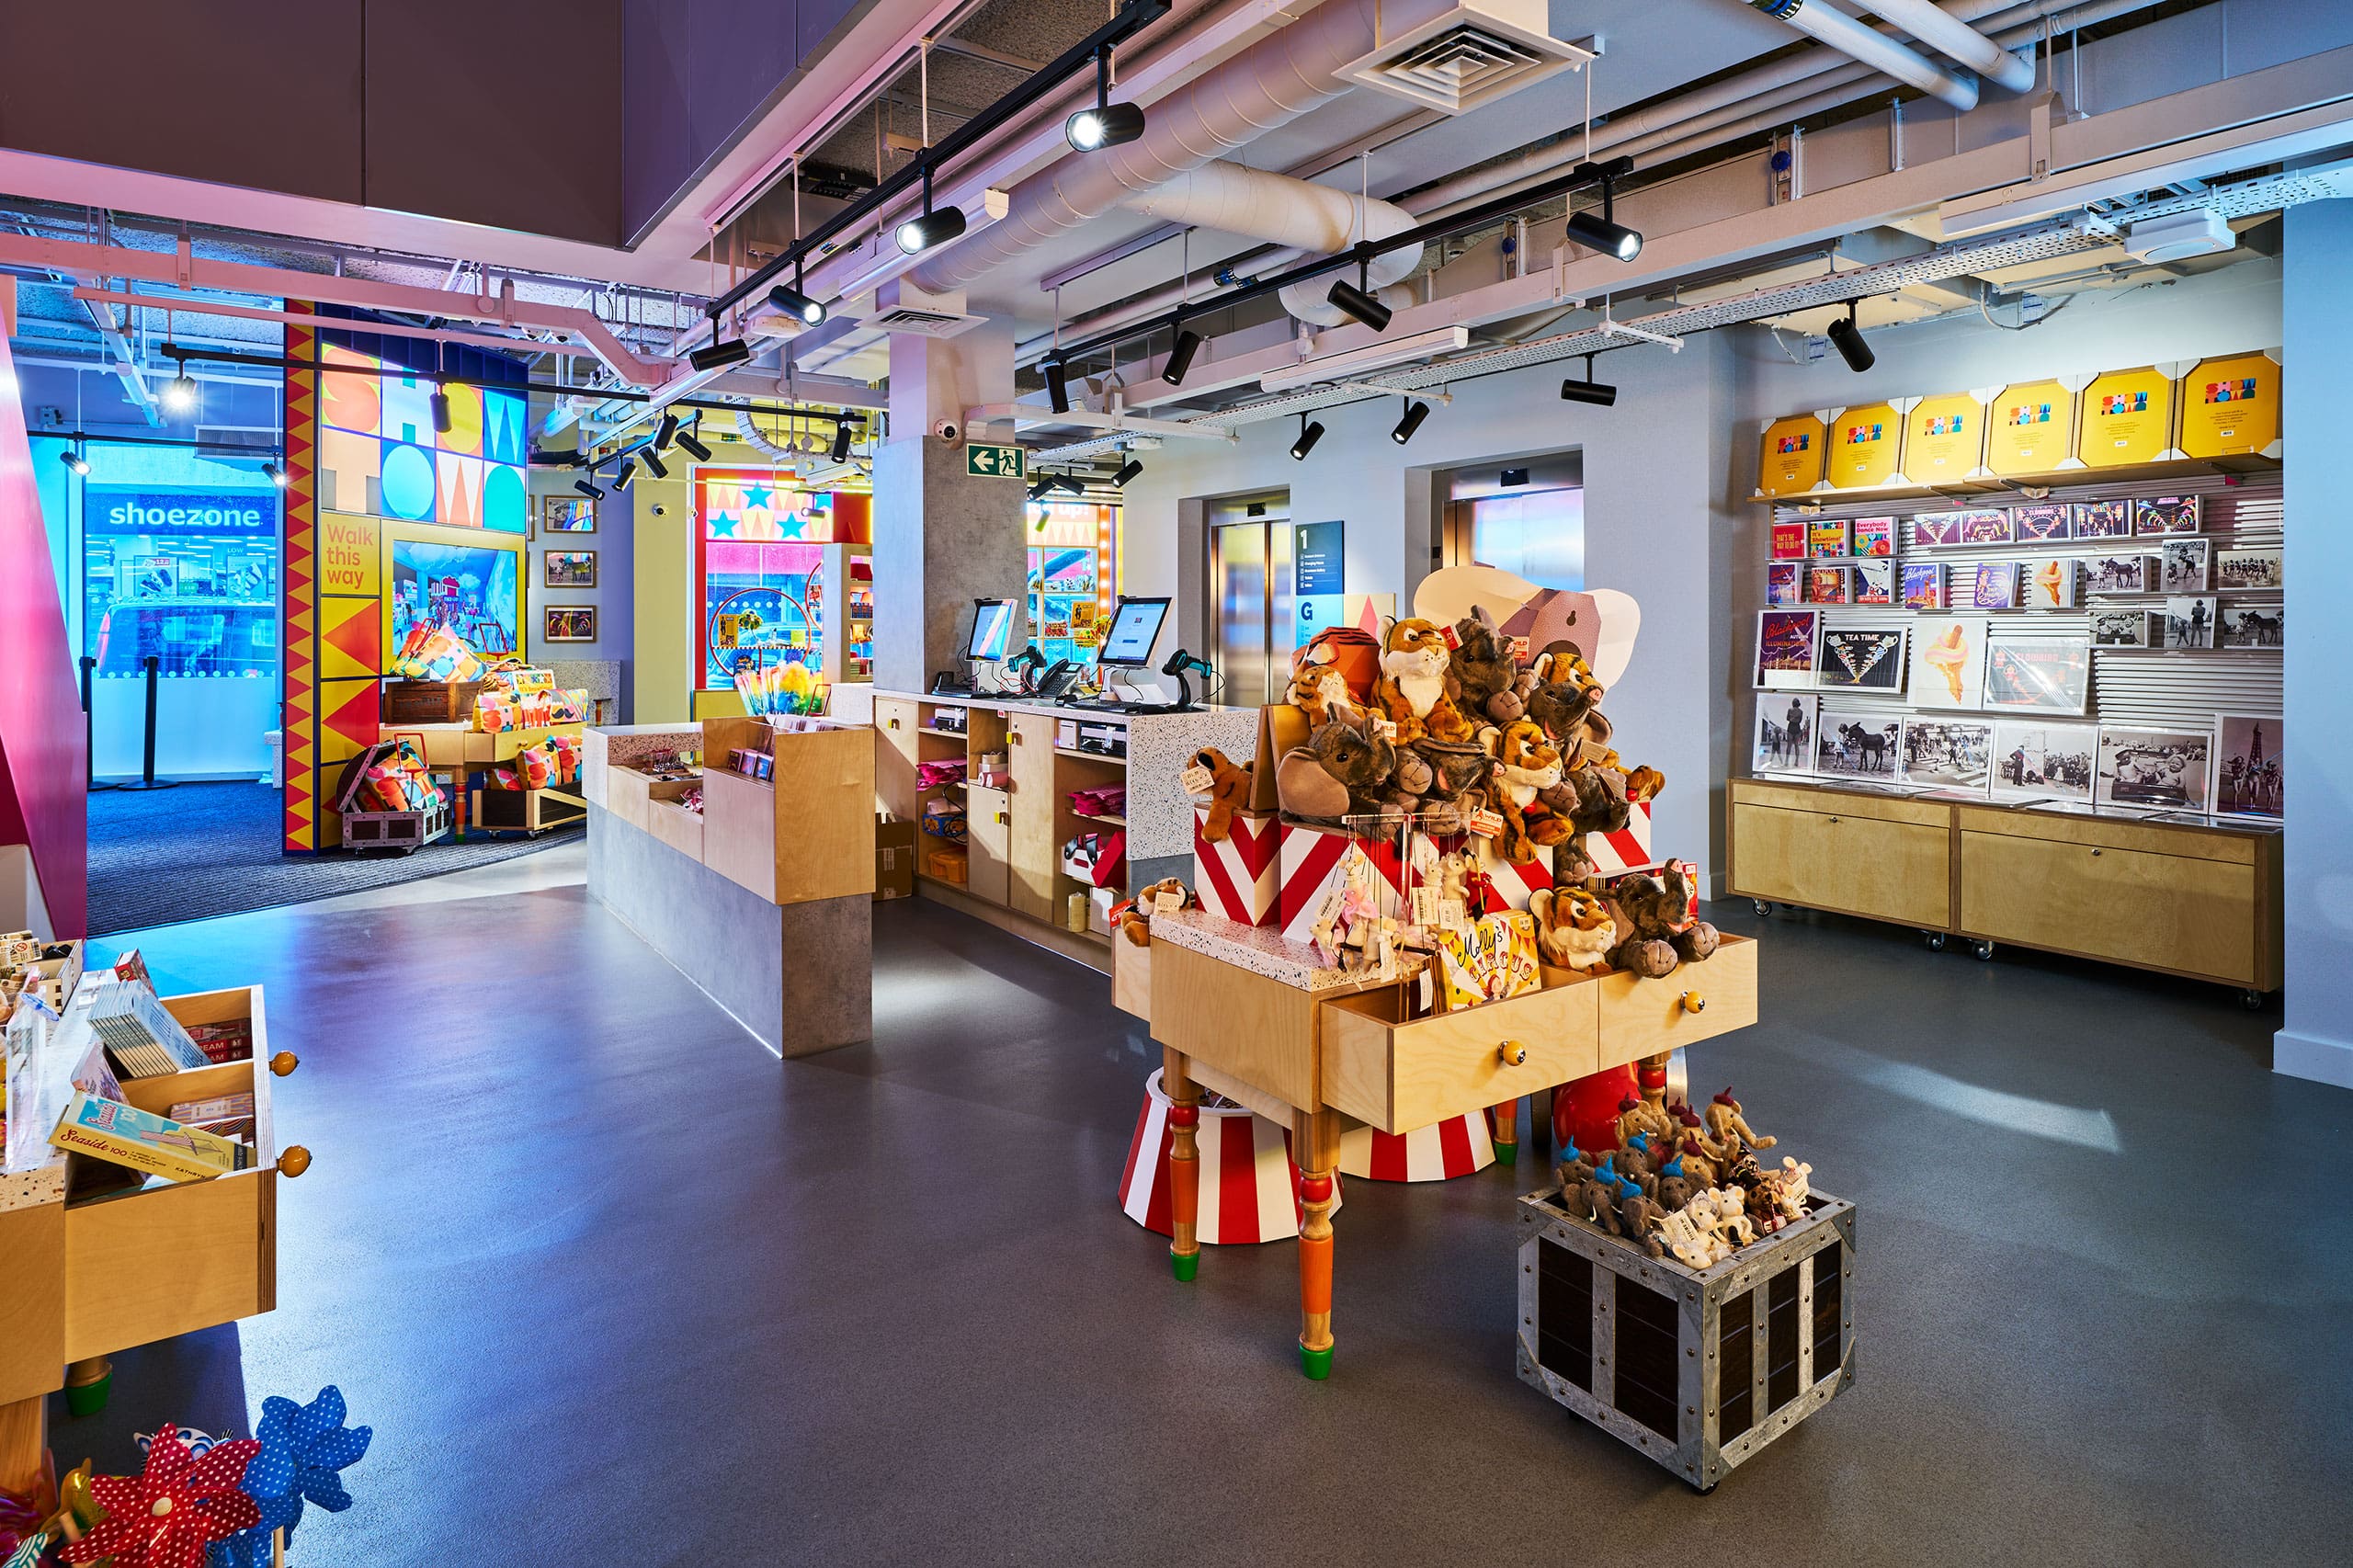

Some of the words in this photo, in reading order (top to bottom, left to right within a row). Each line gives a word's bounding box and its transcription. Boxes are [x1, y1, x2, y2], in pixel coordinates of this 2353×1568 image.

[322, 344, 527, 464] SHOW
[322, 427, 527, 533] TOWN
[109, 502, 261, 527] shoezone
[1857, 521, 1887, 529] Everybody
[326, 524, 374, 547] Walk
[1300, 529, 1308, 550] 1
[326, 546, 361, 566] this
[326, 569, 364, 589] way
[1904, 564, 1936, 581] Blackpool
[1301, 601, 1313, 621] G
[1766, 613, 1812, 639] Blackpool
[1860, 633, 1880, 642] TIME
[1484, 813, 1503, 823] WILD
[1457, 926, 1504, 968] Molly's
[1469, 950, 1534, 983] CIRCUS
[86, 1103, 118, 1131] Seaside
[119, 1108, 139, 1123] 100
[61, 1129, 109, 1152] Seaside
[109, 1147, 128, 1157] 100
[175, 1166, 207, 1179] KATHRYN
